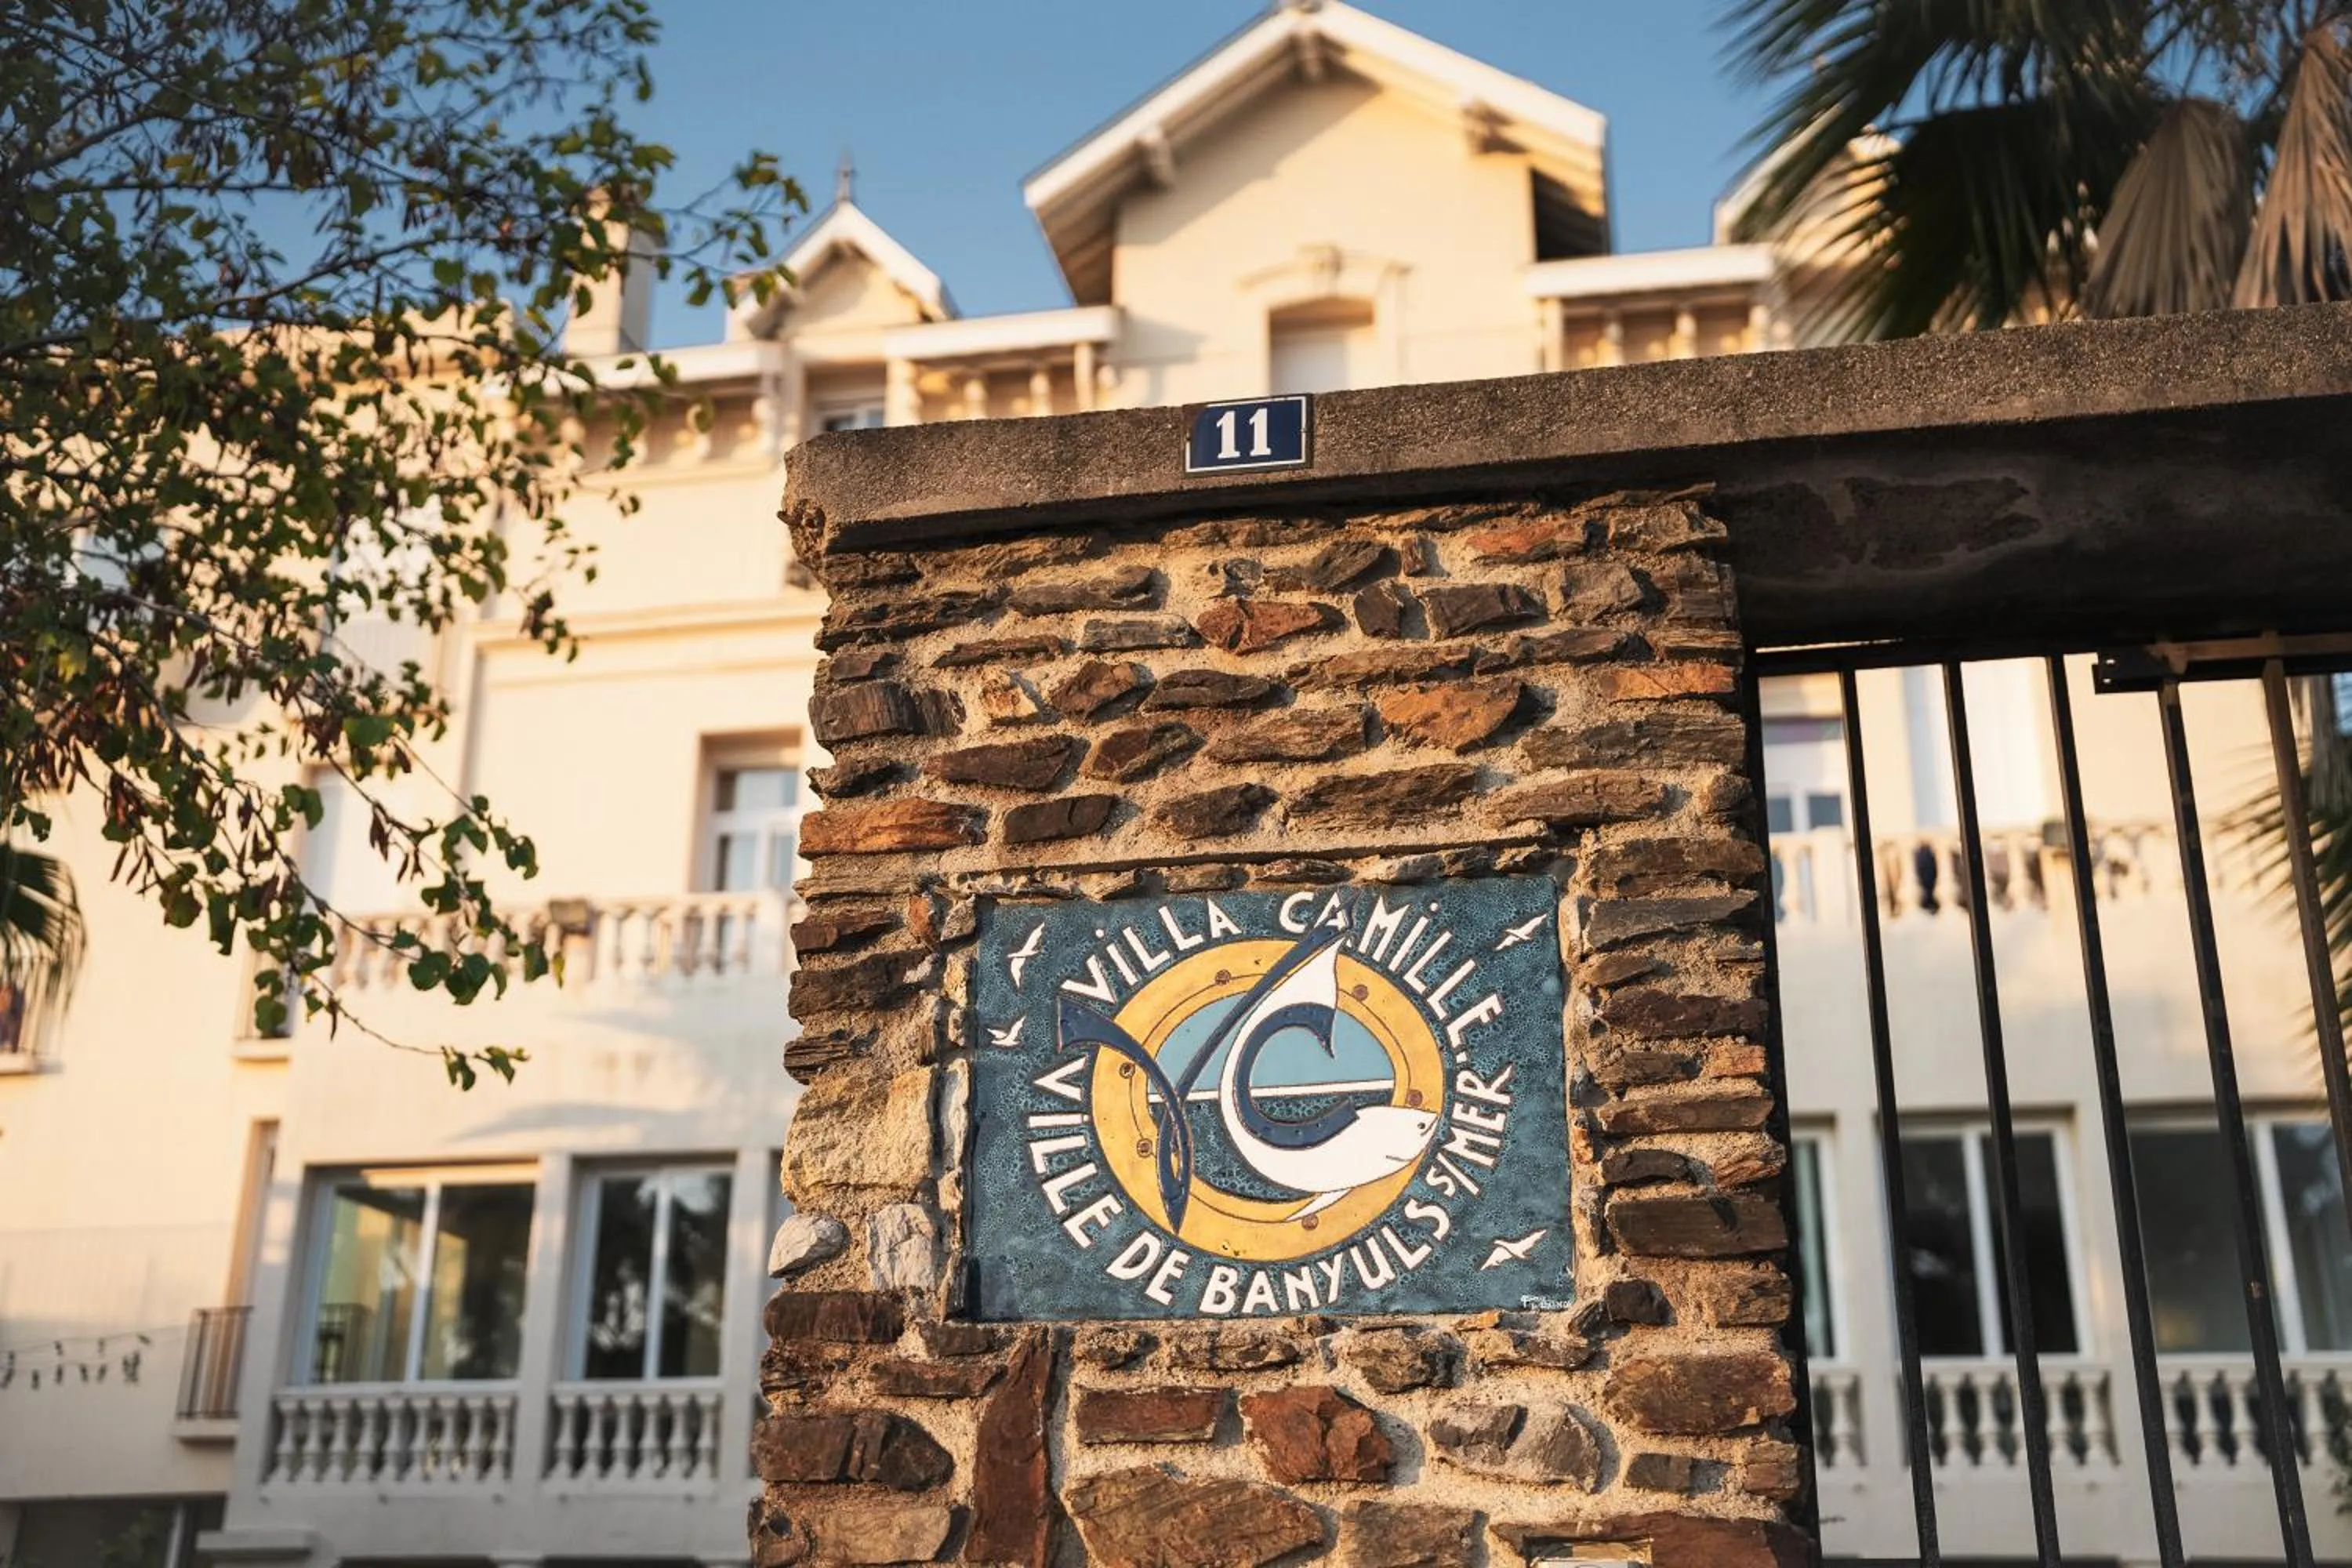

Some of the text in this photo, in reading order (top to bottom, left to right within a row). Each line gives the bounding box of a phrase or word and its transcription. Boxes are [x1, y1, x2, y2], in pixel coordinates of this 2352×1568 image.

[1216, 408, 1272, 459] 11
[1105, 1230, 1192, 1305] DE
[1199, 1199, 1450, 1314] BANYULS
